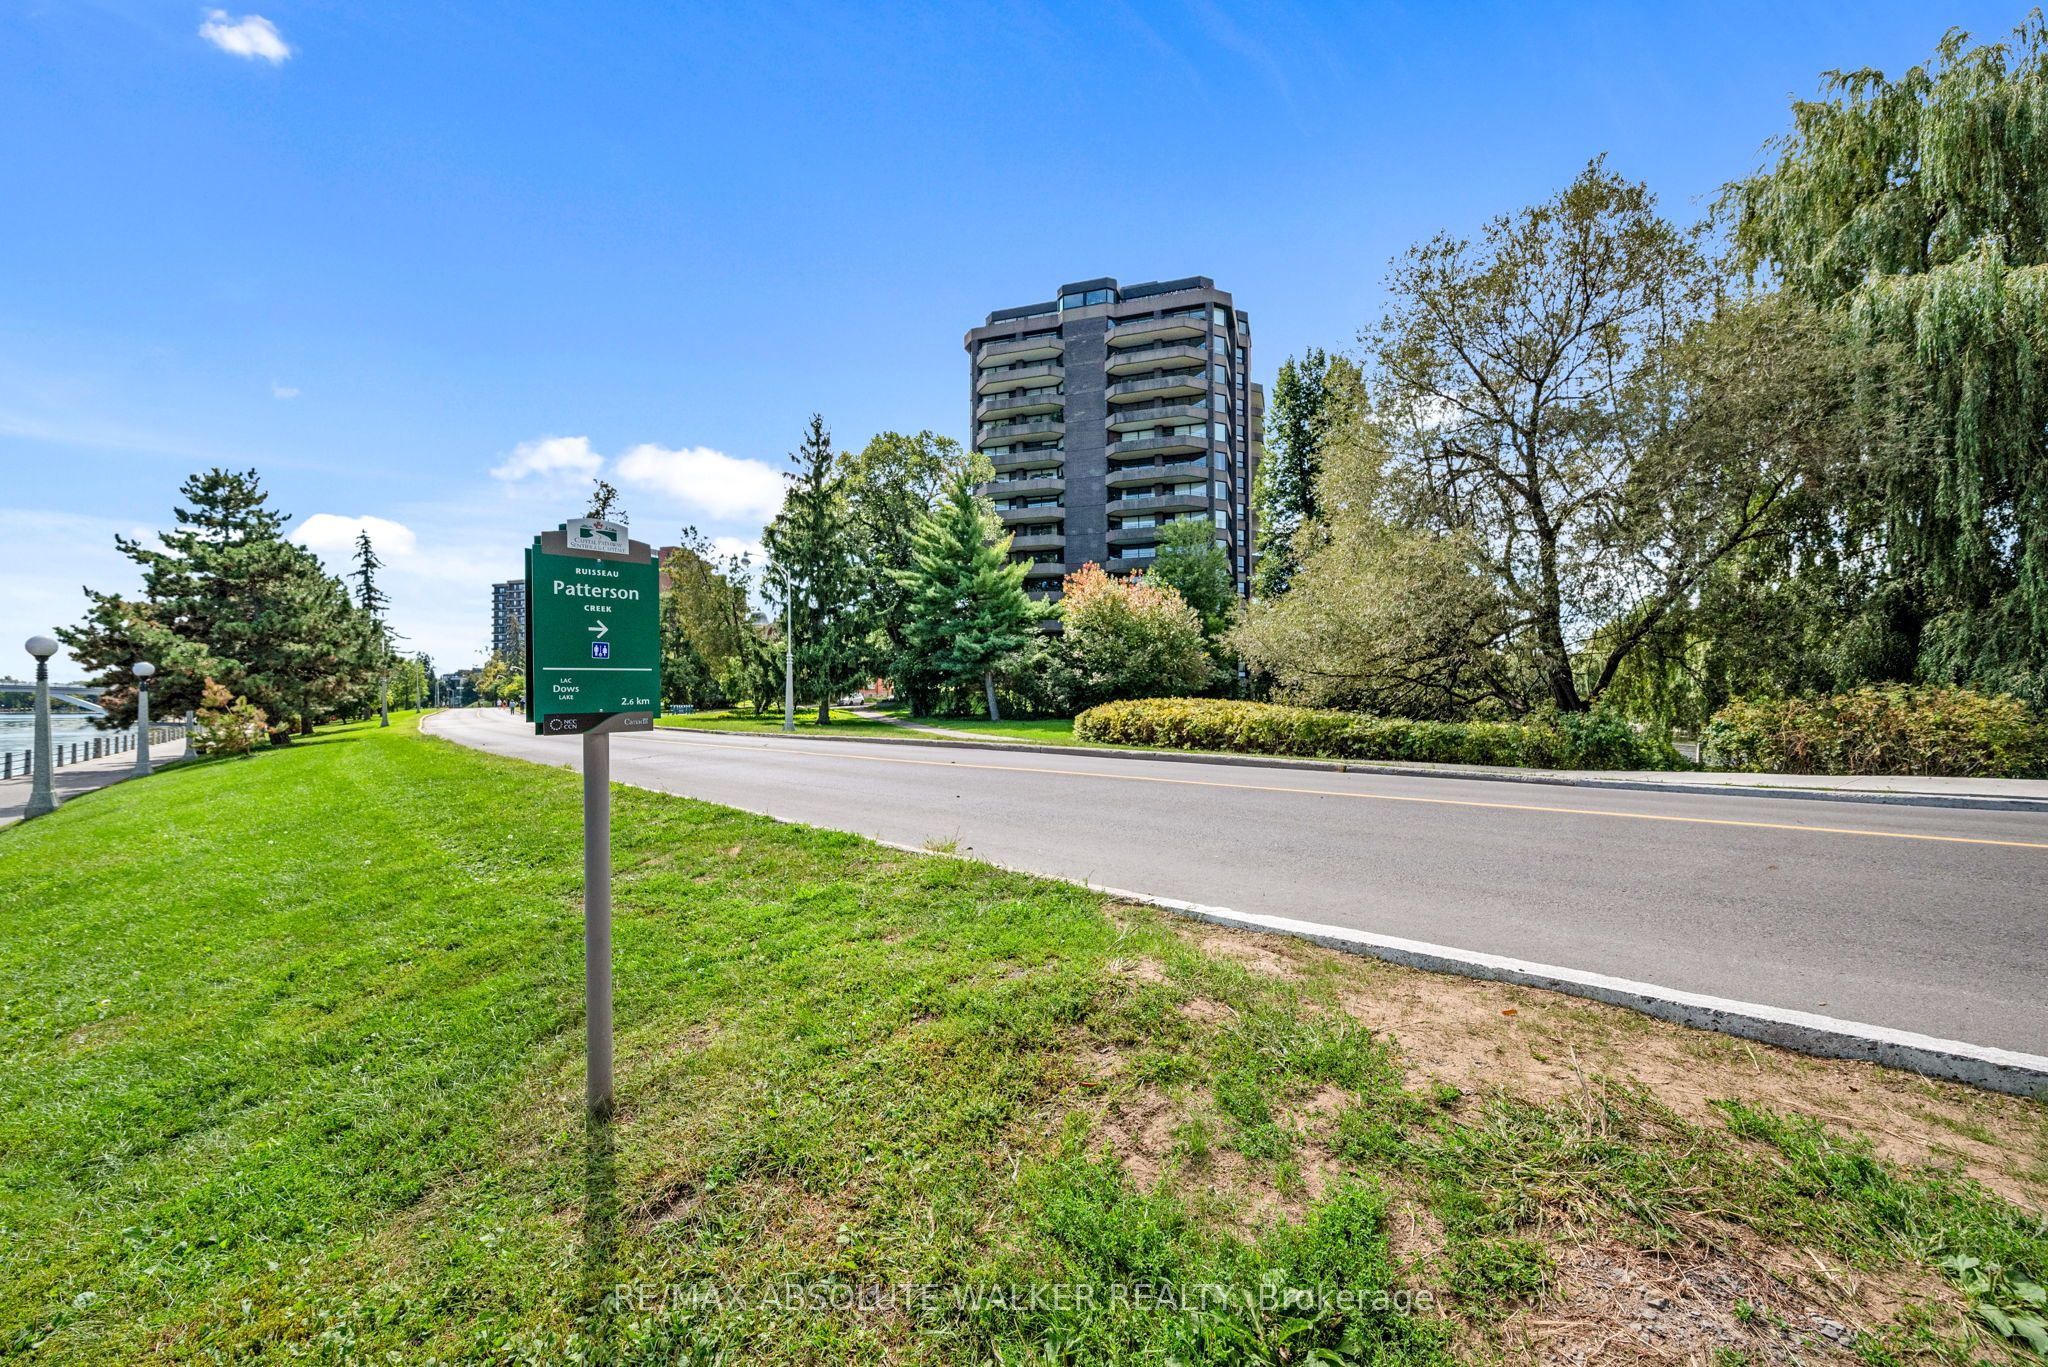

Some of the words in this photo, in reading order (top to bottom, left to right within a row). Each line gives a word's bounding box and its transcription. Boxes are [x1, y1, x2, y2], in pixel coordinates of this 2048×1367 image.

[575, 567, 619, 578] RUISSEAU
[553, 580, 640, 601] Patterson
[584, 604, 612, 613] CREEK
[553, 684, 580, 693] Dows
[621, 697, 635, 706] 2.6
[636, 696, 650, 705] km
